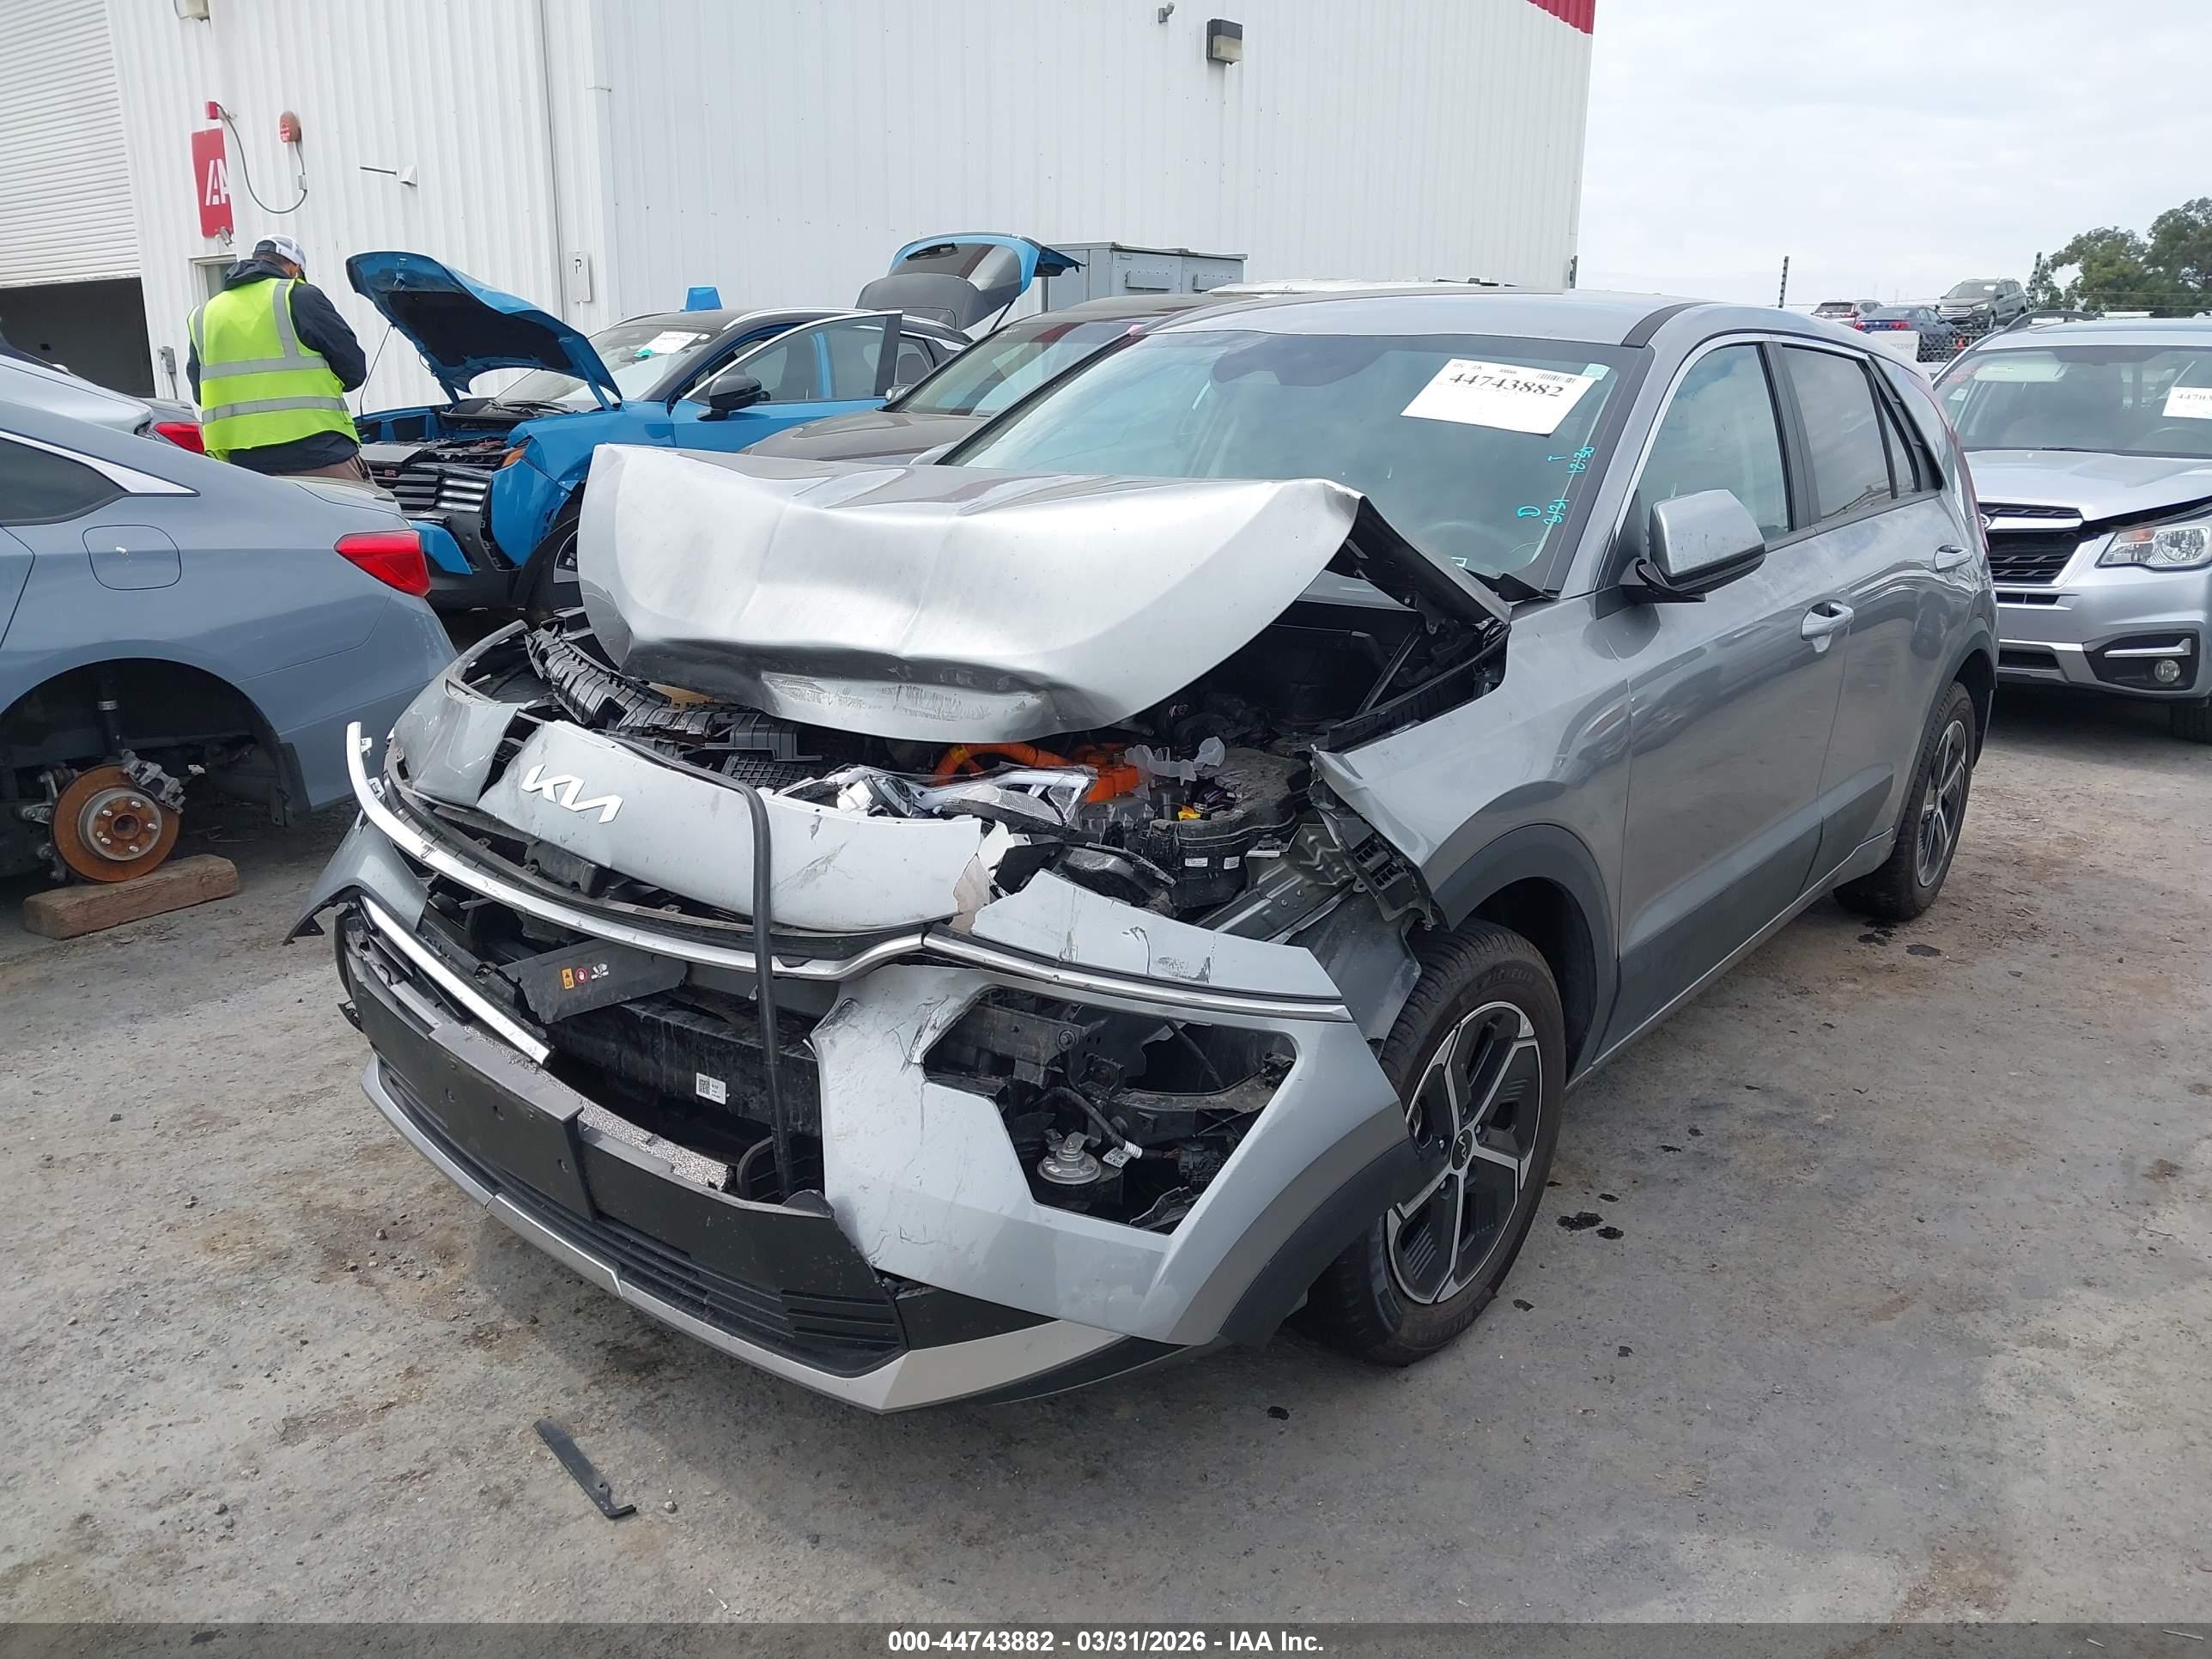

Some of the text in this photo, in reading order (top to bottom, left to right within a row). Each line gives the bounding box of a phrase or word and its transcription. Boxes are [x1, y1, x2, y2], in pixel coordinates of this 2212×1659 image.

[1449, 372, 1565, 398] 44743882
[1516, 504, 1542, 519] D
[1543, 498, 1571, 526] 3/31
[521, 763, 624, 824] KIA
